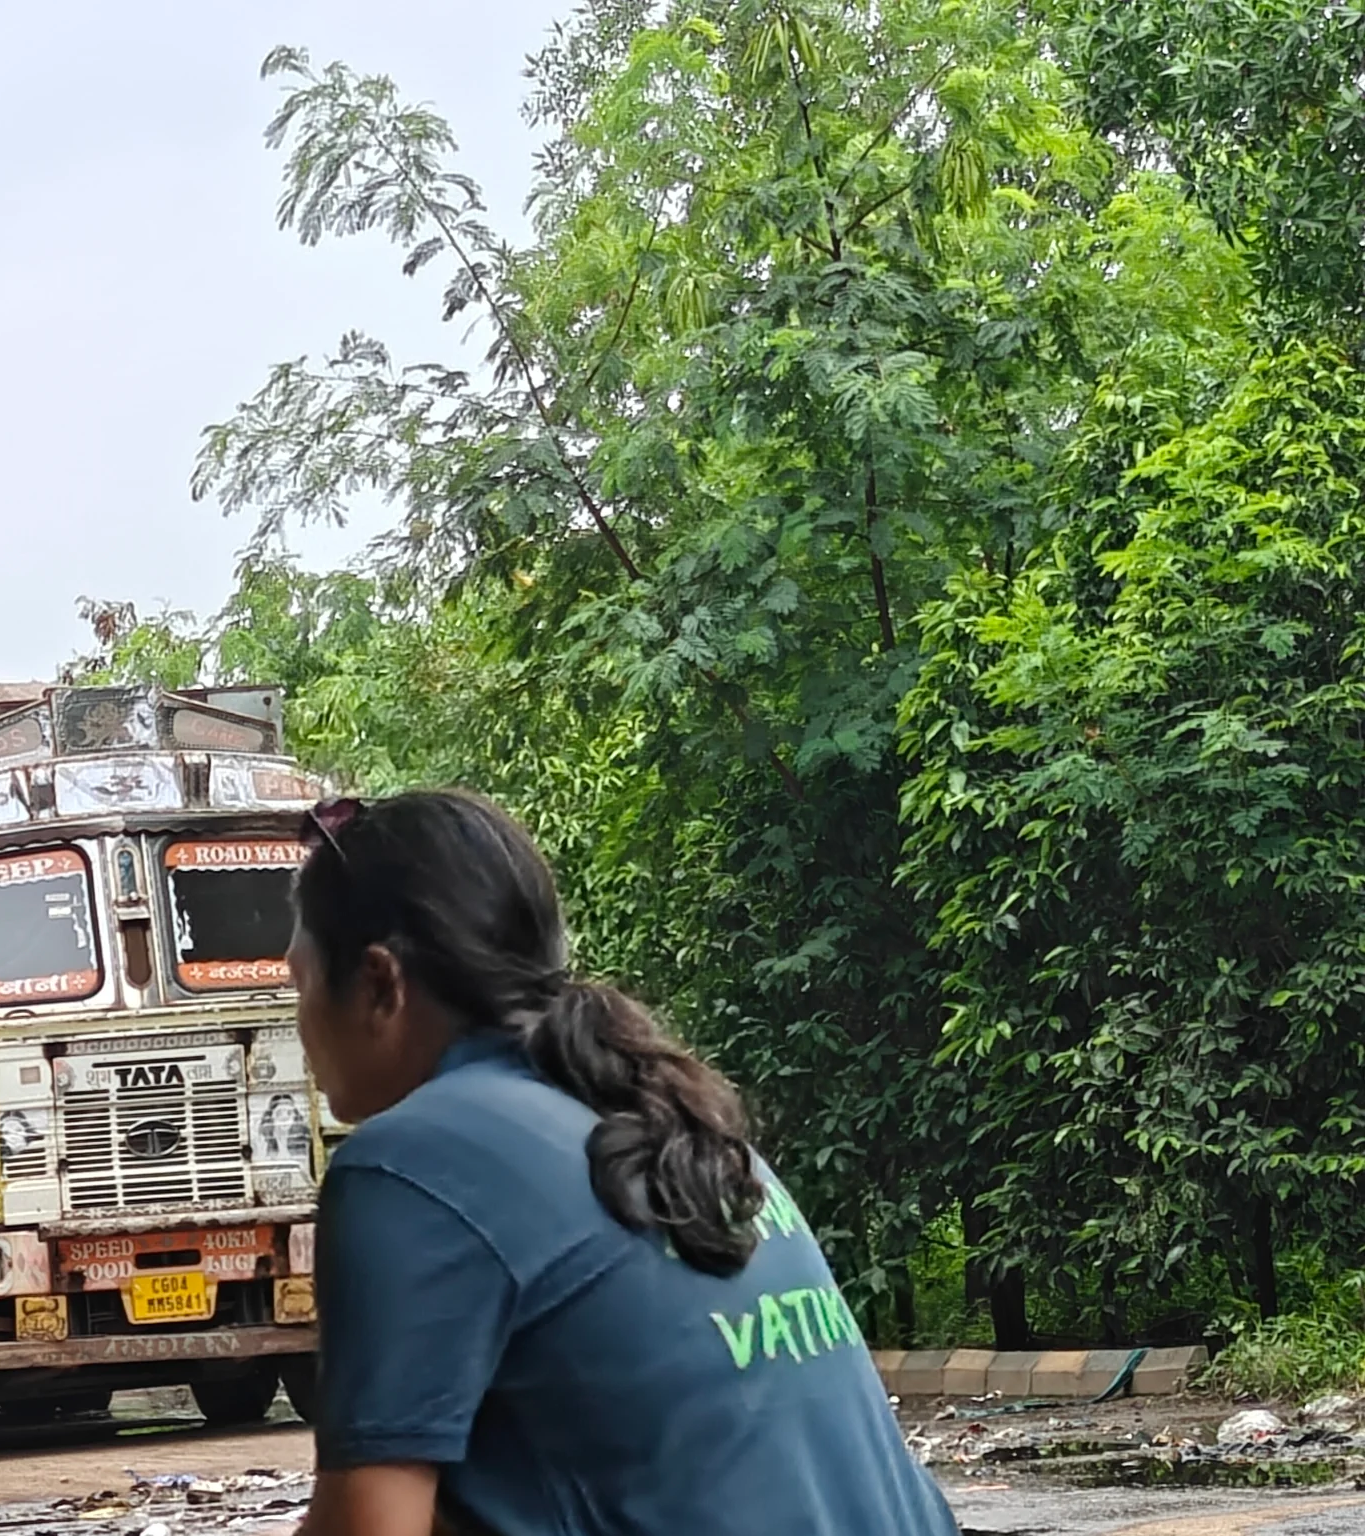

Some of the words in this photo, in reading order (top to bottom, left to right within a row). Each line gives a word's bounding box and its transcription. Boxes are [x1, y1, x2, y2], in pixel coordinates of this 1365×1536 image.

[114, 1064, 185, 1087] TATA
[70, 1239, 134, 1261] SPEED
[203, 1229, 257, 1251] 40KM
[151, 1276, 188, 1294] CG04
